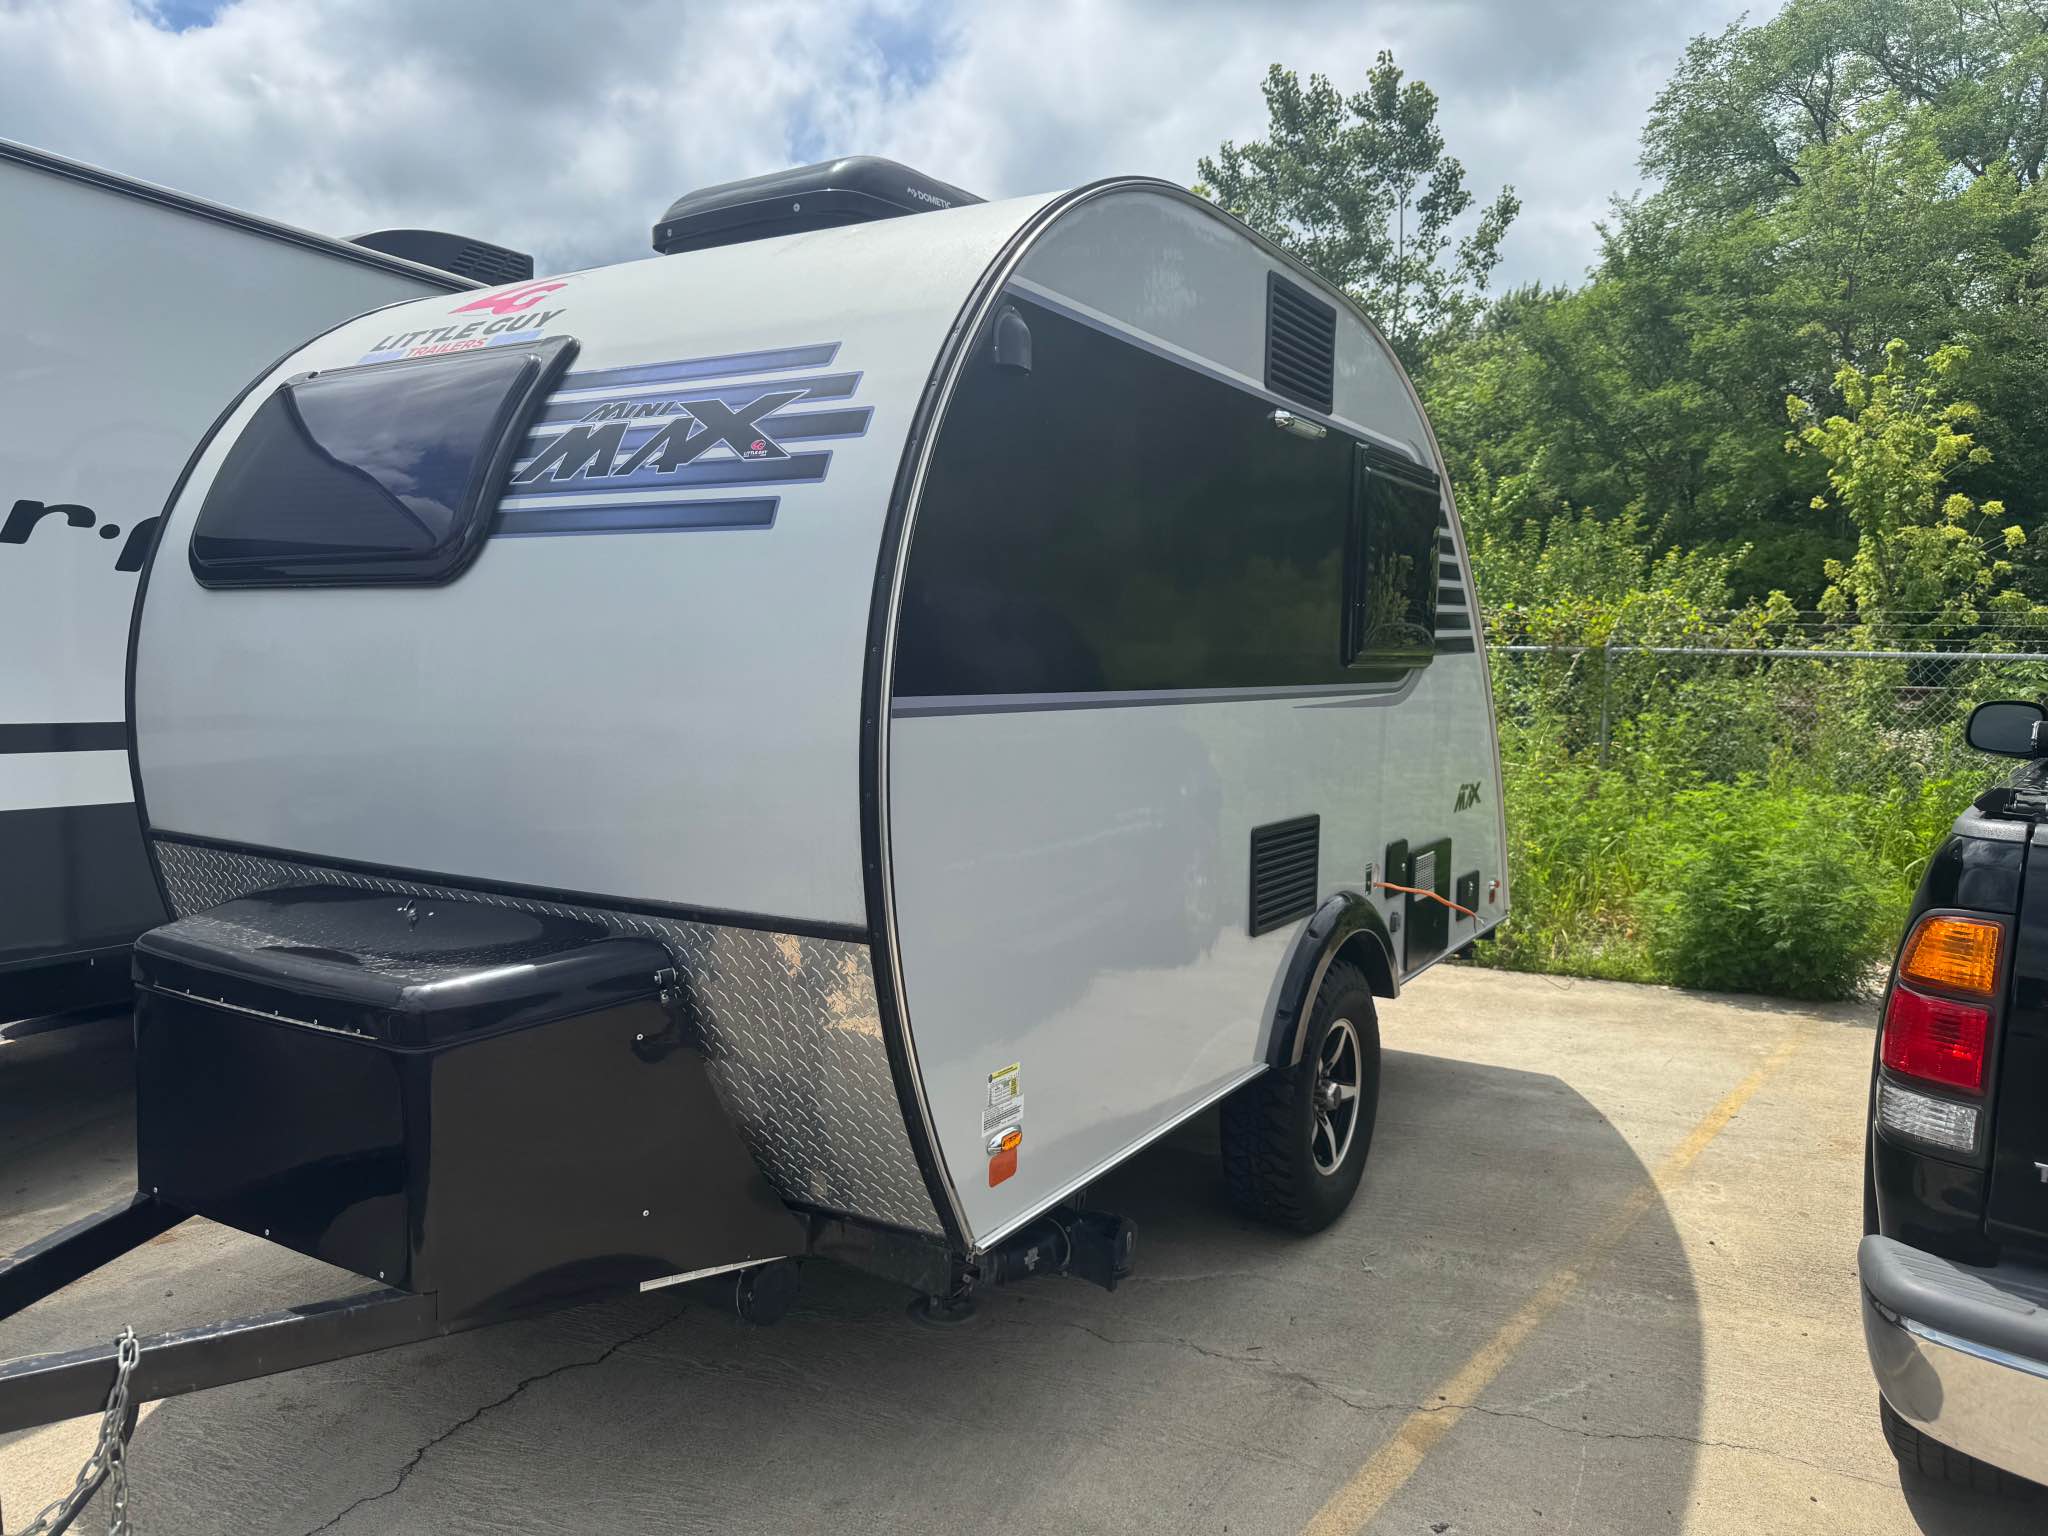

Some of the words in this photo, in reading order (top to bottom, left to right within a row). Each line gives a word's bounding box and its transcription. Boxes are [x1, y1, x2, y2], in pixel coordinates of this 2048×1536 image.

[917, 190, 952, 209] DOMETIC
[369, 320, 488, 353] LITTLE
[482, 308, 567, 336] GUY
[406, 337, 489, 358] TRAILERS
[577, 400, 678, 423] MINI
[510, 388, 811, 484] MAX
